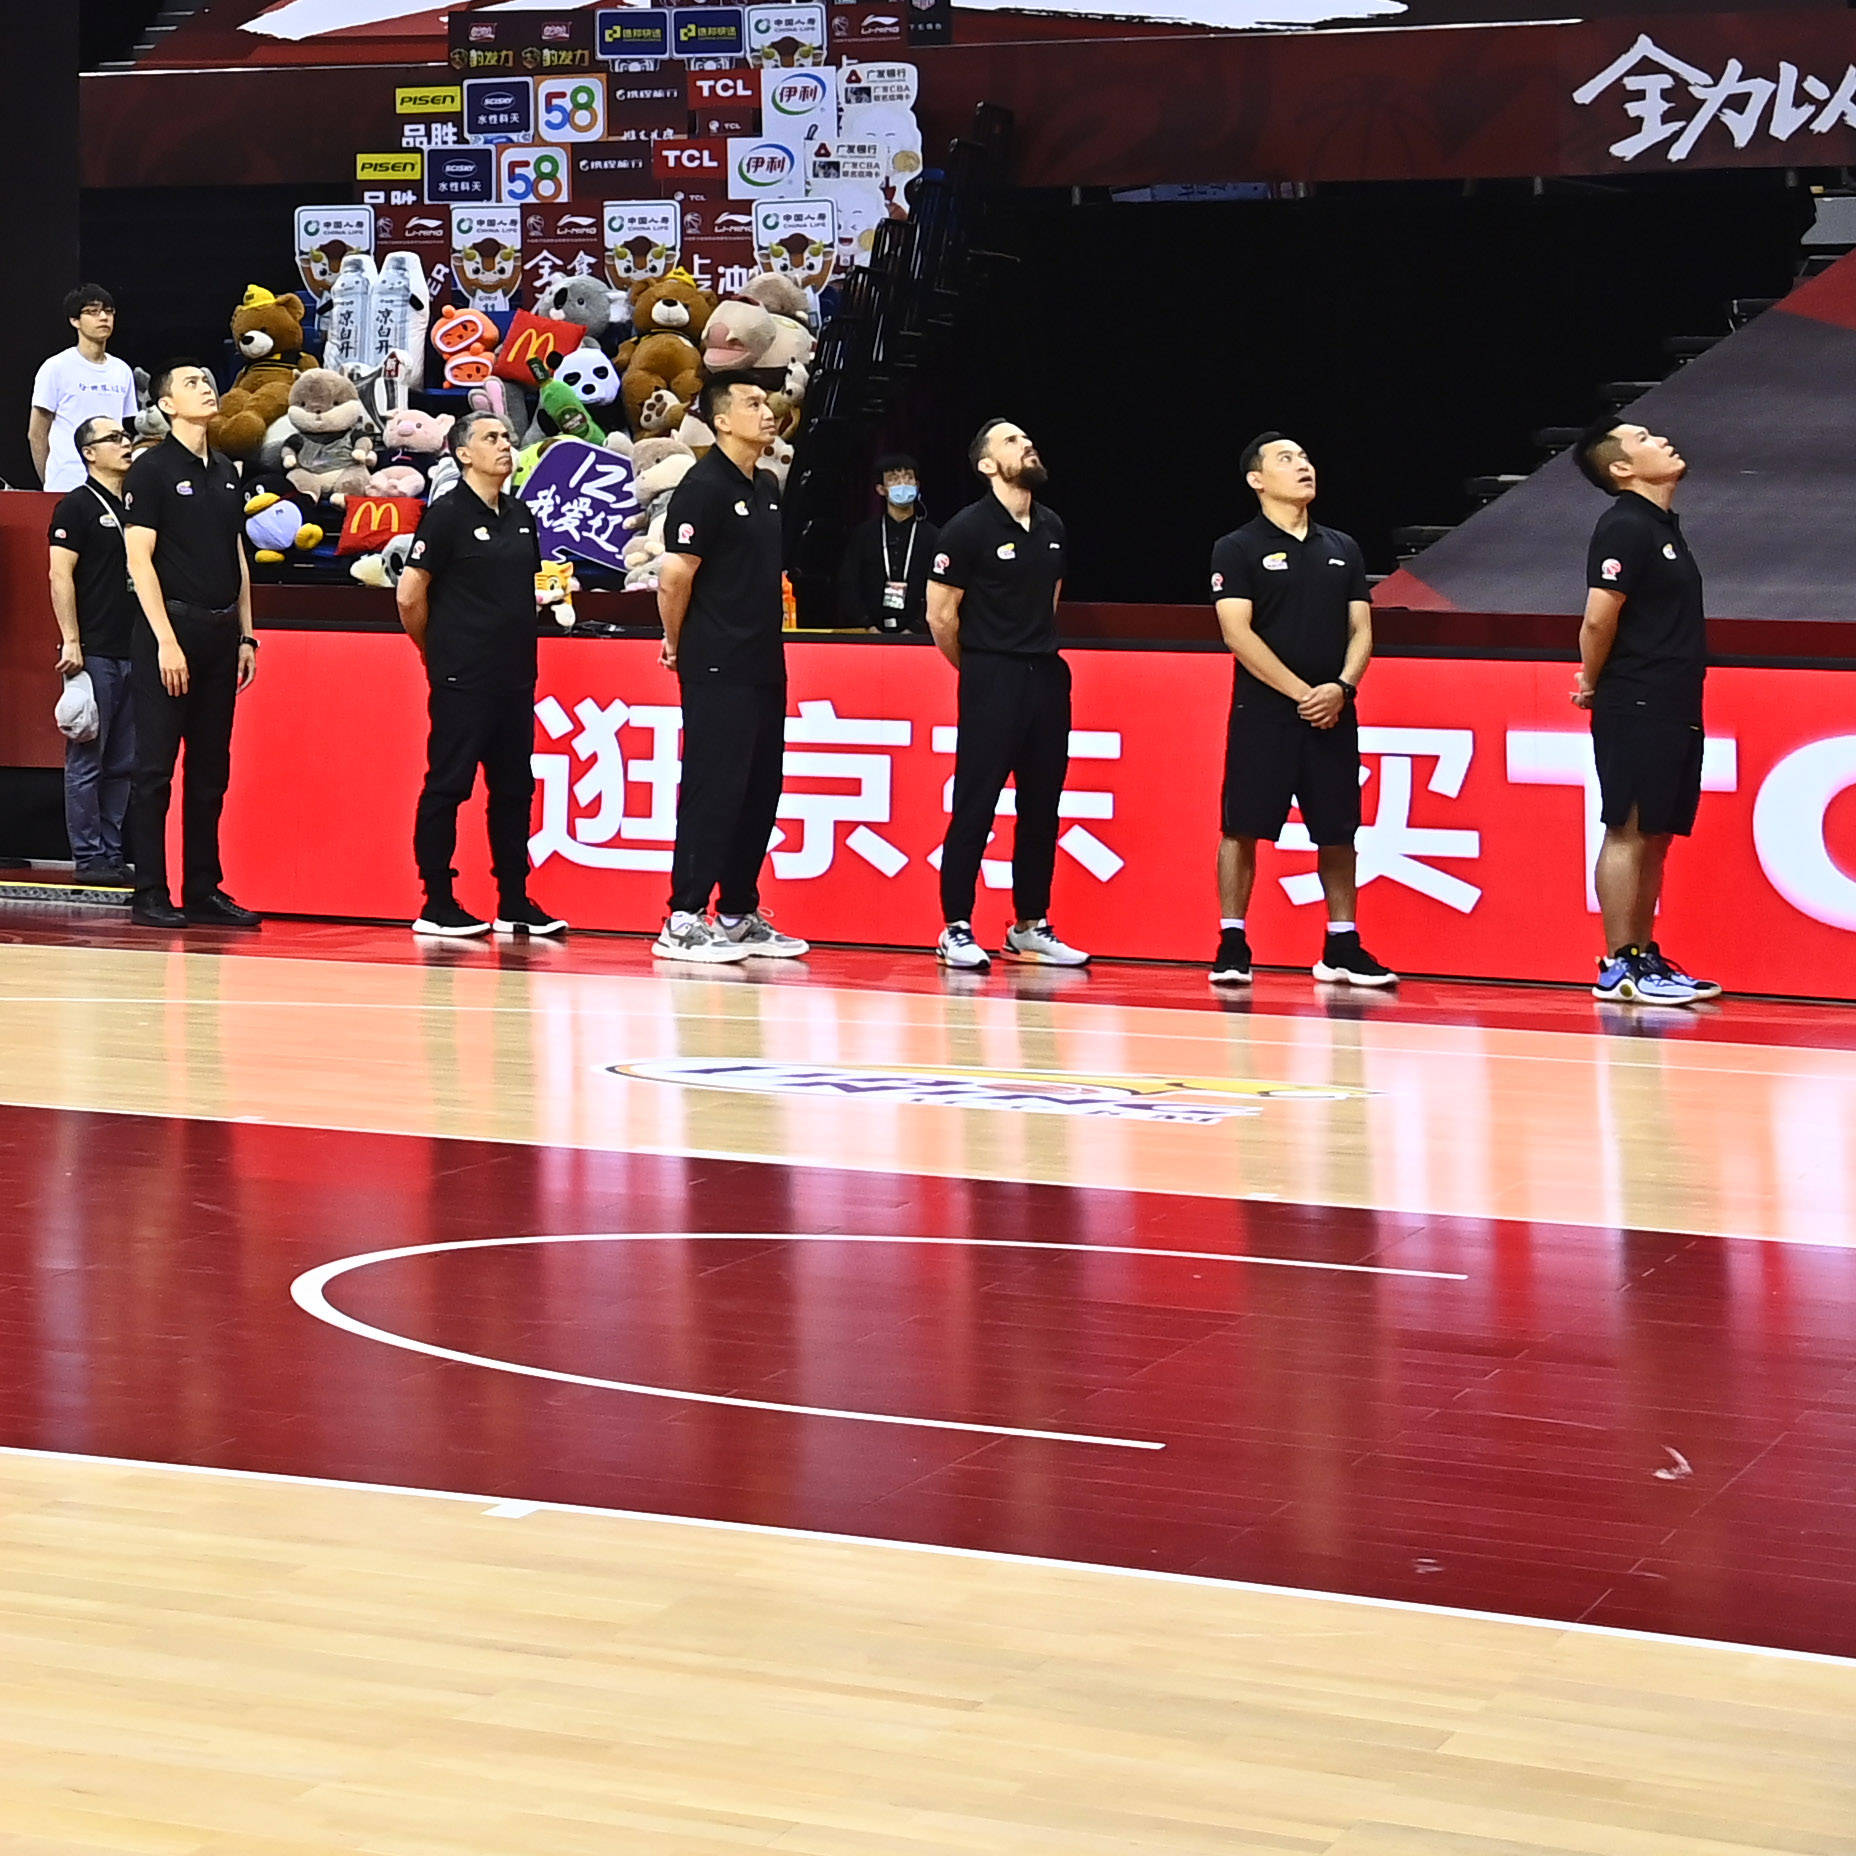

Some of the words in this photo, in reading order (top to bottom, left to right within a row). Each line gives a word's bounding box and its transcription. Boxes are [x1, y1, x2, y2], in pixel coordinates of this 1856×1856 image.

[696, 78, 753, 97] TCL
[779, 85, 818, 104] 伊利
[399, 94, 456, 107] PISEN
[544, 85, 598, 133] 58
[360, 161, 416, 173] PISEN
[661, 149, 719, 167] TCL
[746, 155, 786, 173] 伊利
[507, 154, 563, 201] 58
